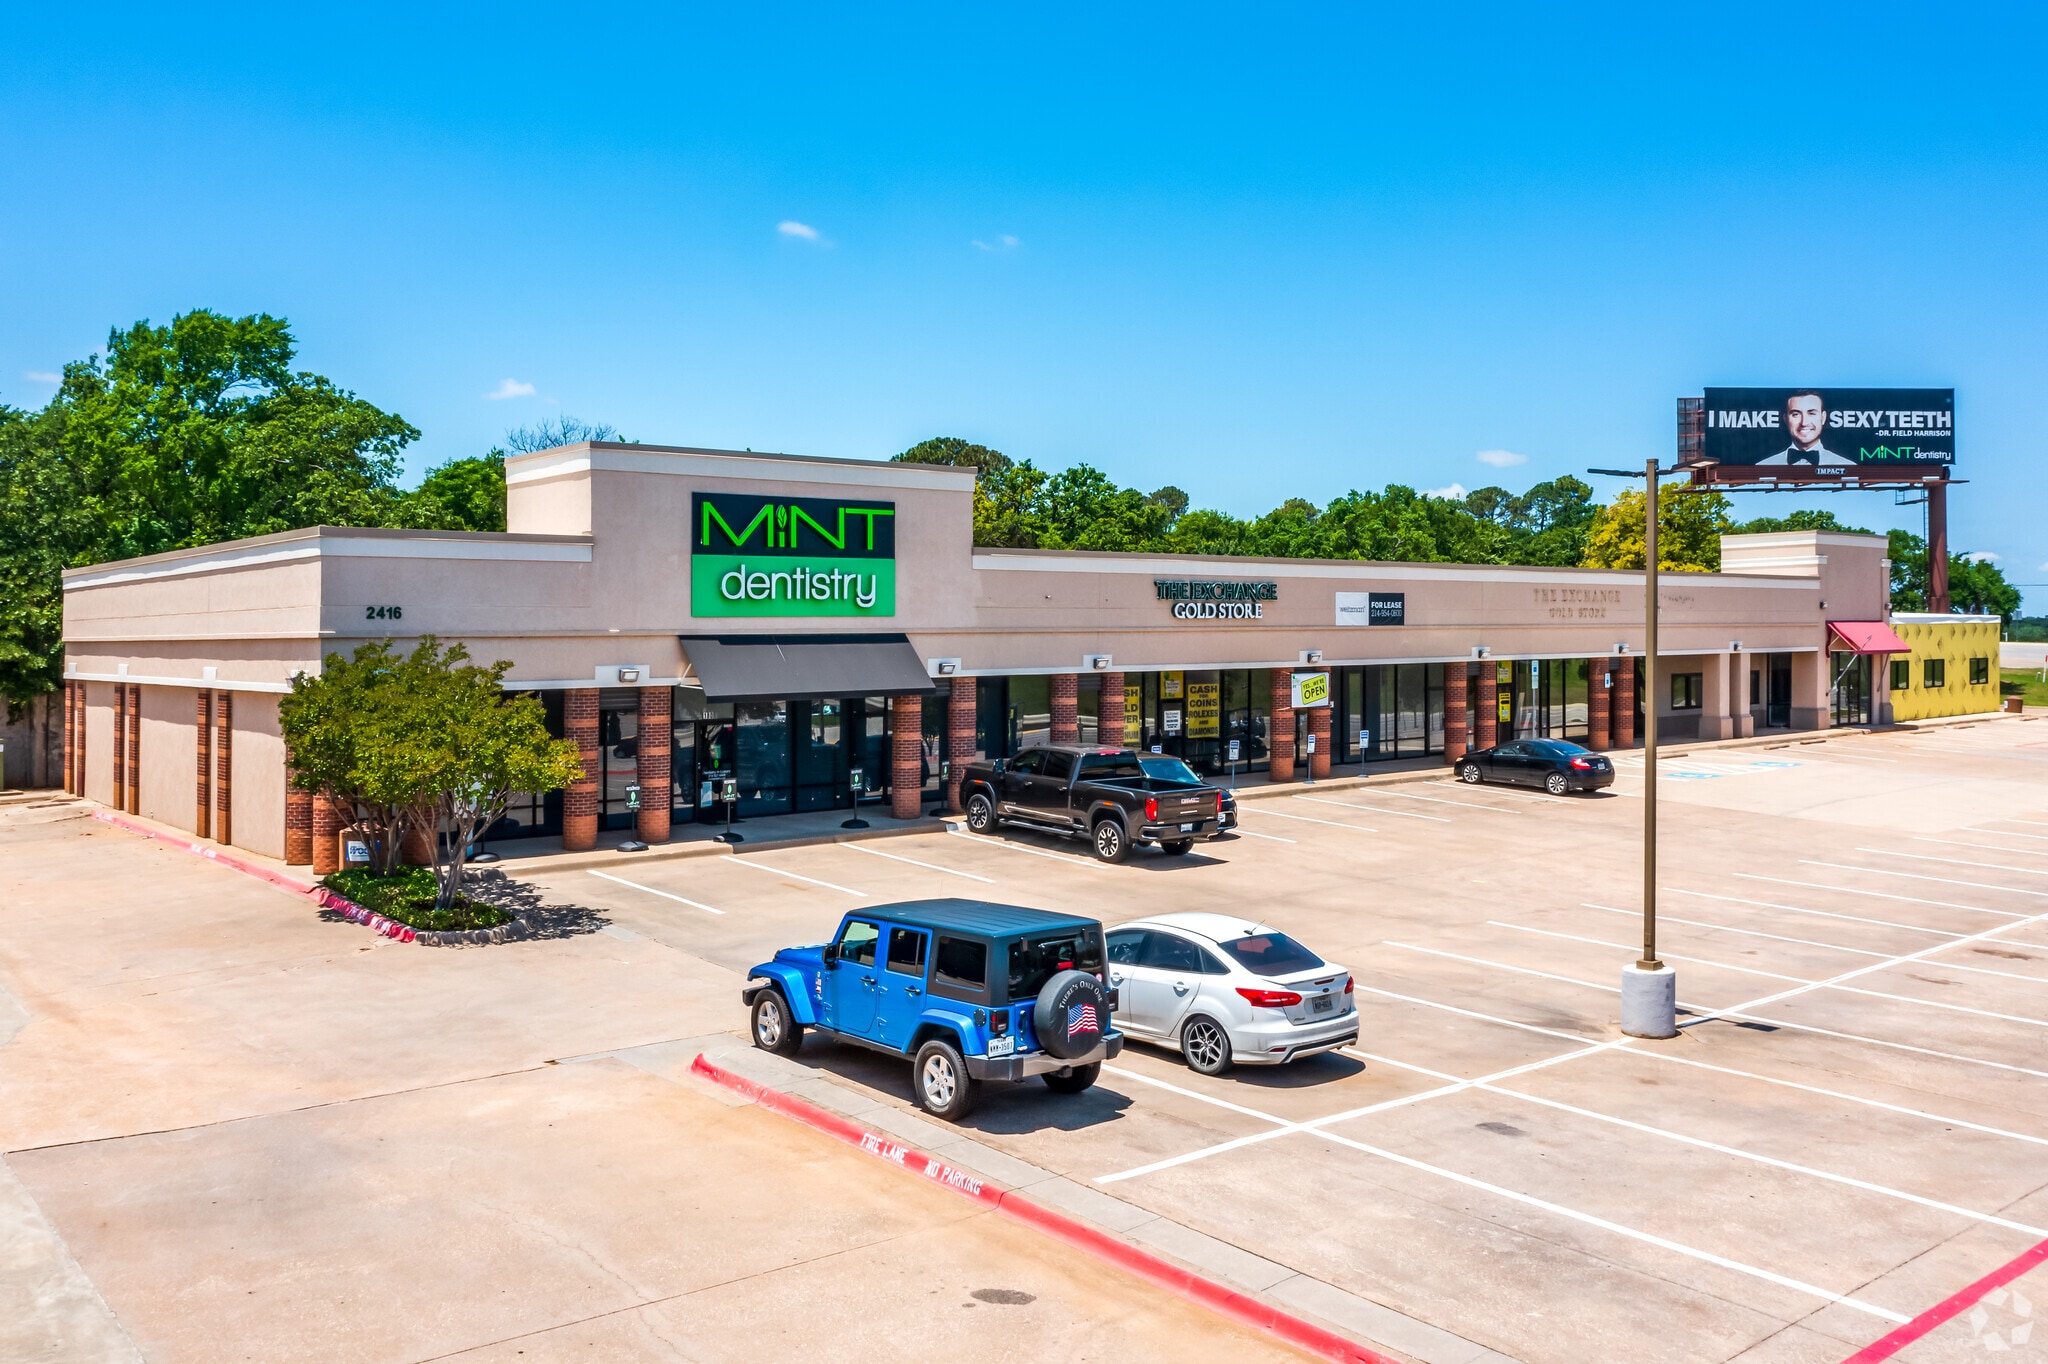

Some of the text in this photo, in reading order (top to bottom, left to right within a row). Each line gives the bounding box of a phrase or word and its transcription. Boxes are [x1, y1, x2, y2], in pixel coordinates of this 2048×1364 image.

[1708, 410, 1779, 428] I MAKE
[1829, 410, 1951, 428] SEXY TEETH
[1914, 447, 1951, 460] dentistry
[1817, 467, 1846, 475] IMPACT
[721, 564, 876, 608] dentistry
[1156, 580, 1278, 601] THE EXCHANGE
[1533, 588, 1621, 603] THE EXCHANGE
[1173, 602, 1263, 619] GOLD STORE
[1371, 601, 1402, 609] FOR LEASE
[366, 606, 402, 620] 2416
[1189, 685, 1218, 694] CASH
[1304, 684, 1326, 699] OPEN
[1189, 699, 1218, 708] COINS
[1188, 709, 1218, 719] ROLEXES
[1188, 726, 1218, 736] DIAMONDS
[1059, 983, 1079, 1009] THERE'S
[860, 1132, 984, 1196] FIRE LANE NO PARKING
